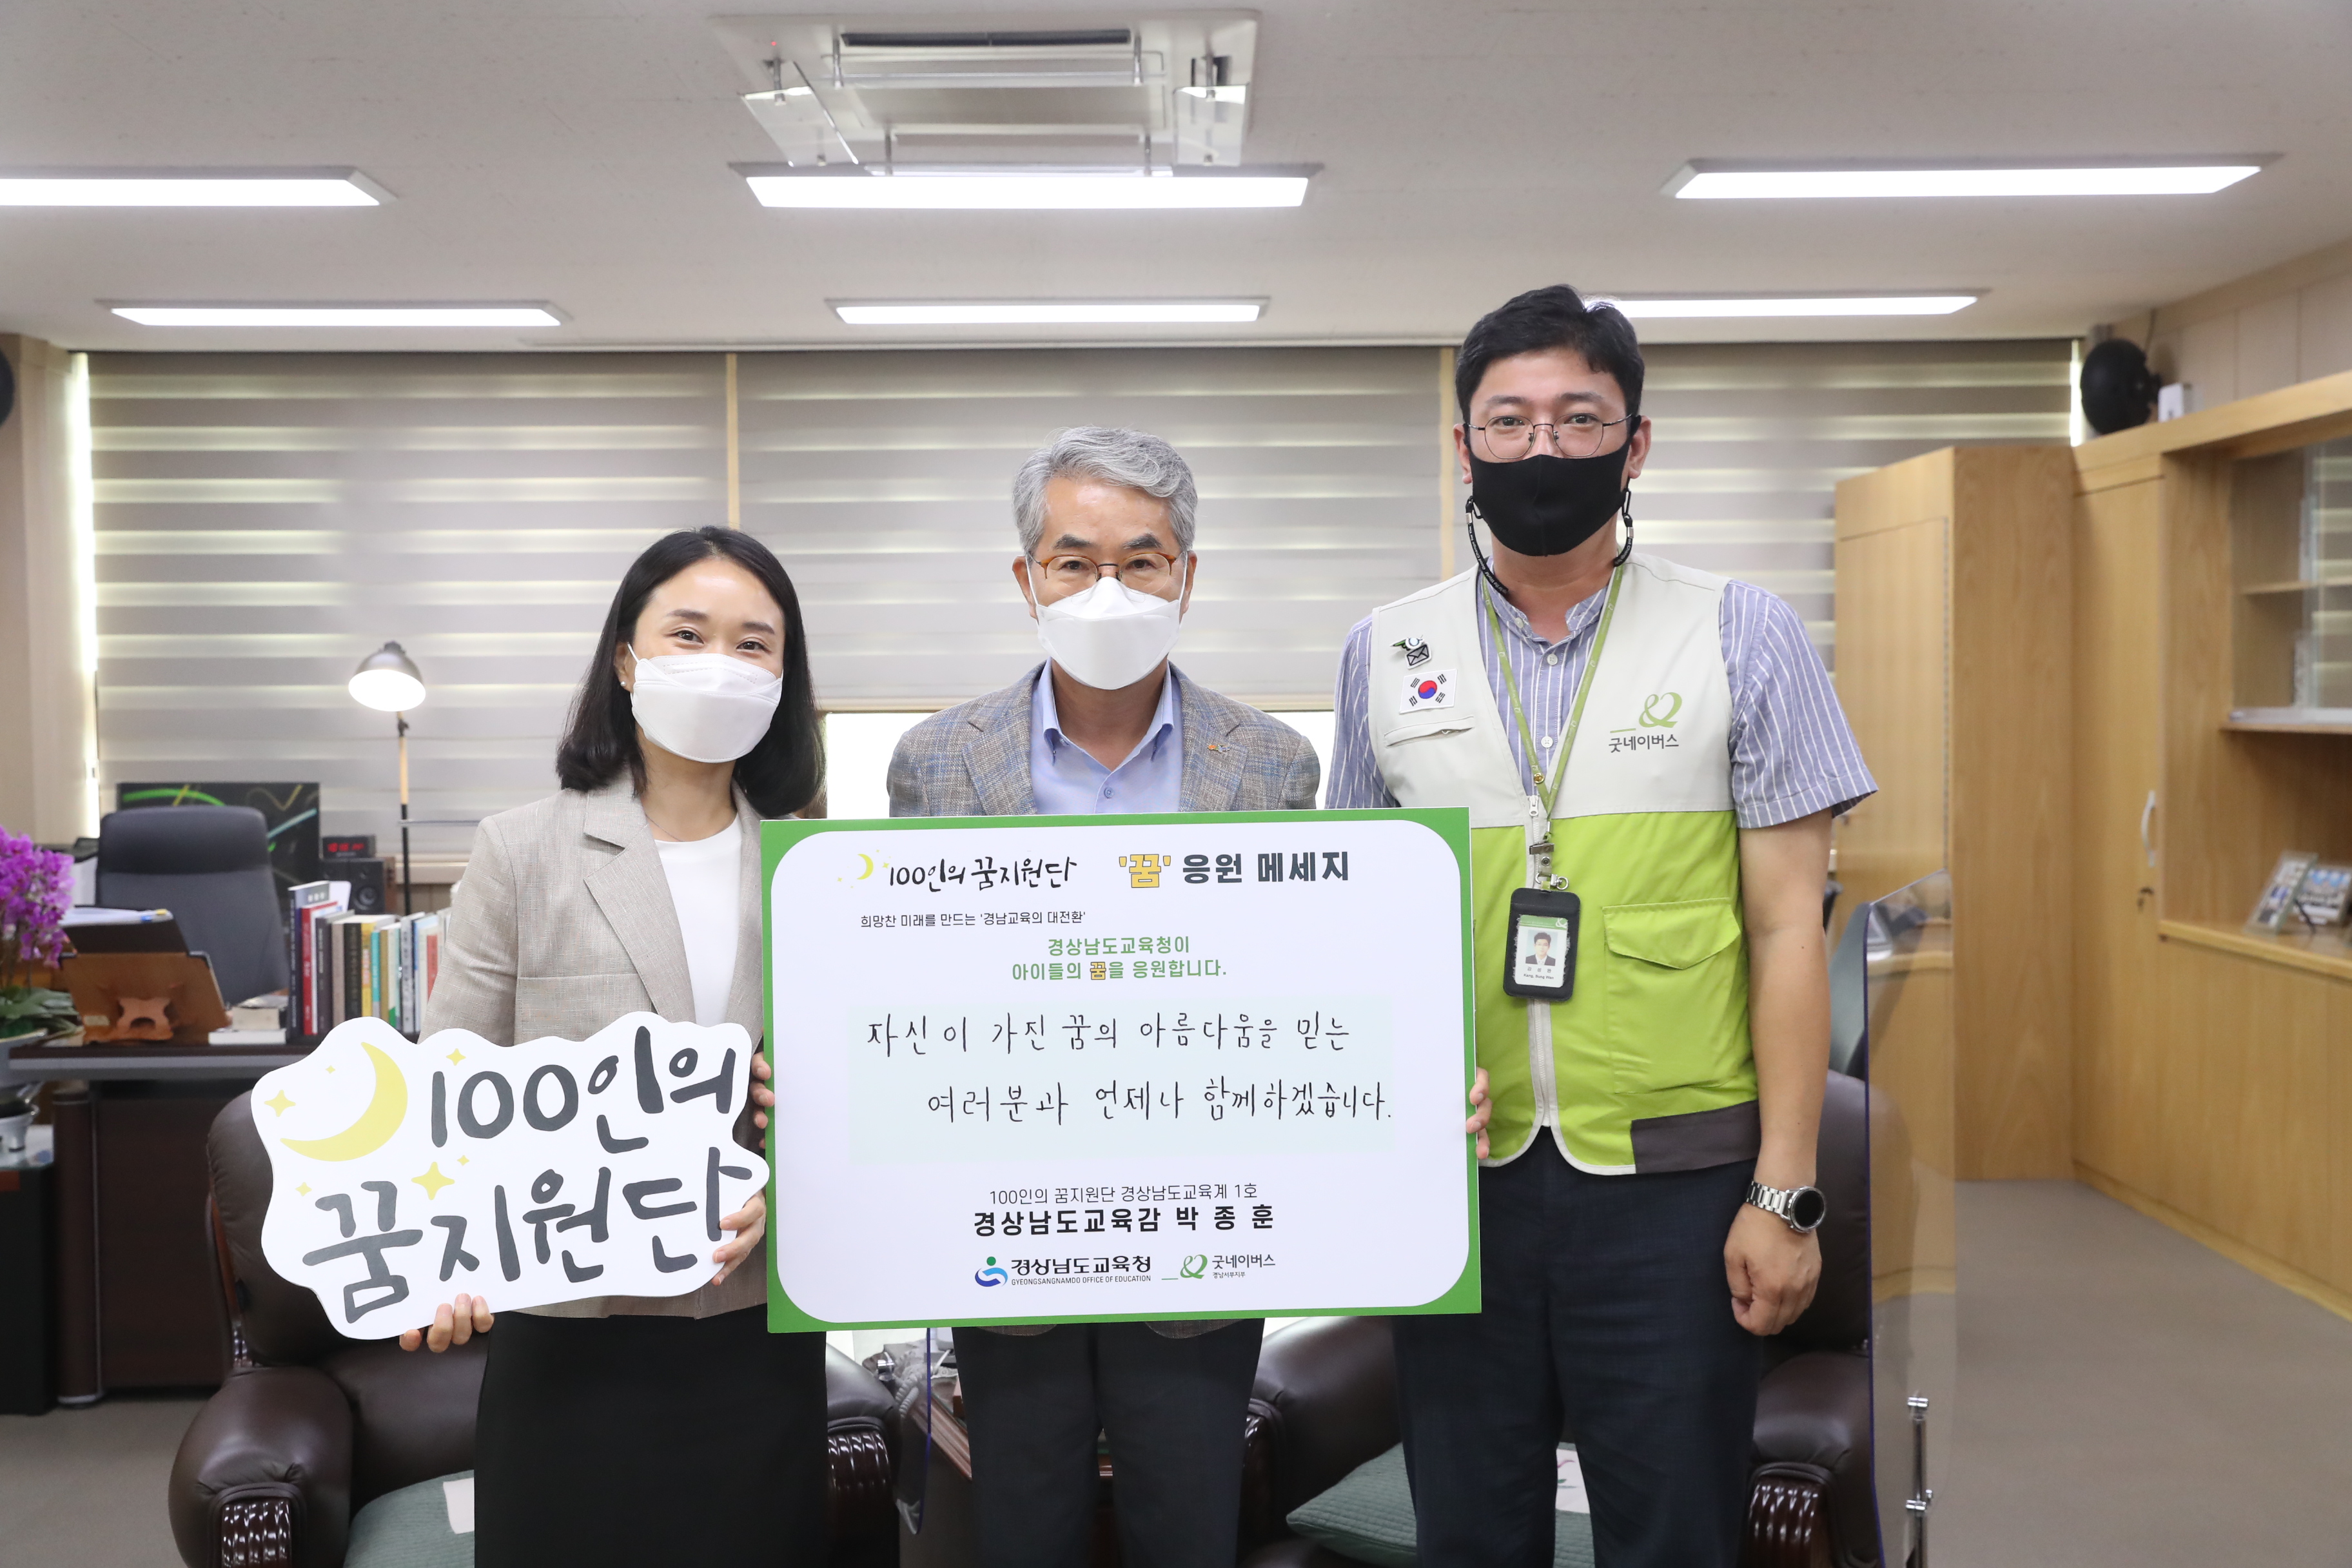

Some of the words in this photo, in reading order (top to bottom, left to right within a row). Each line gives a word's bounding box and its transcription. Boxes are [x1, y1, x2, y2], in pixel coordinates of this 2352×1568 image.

[1609, 734, 1679, 752] 굿네이버스
[1183, 854, 1242, 883] 응원
[1258, 852, 1348, 882] 메세지
[861, 916, 896, 927] 희망찬
[901, 915, 936, 926] 미래를
[941, 914, 975, 926] 만드는
[981, 912, 1042, 925] '경남교육의
[1048, 911, 1085, 923] 대전환'
[1048, 936, 1188, 956] 경상남도교육청이
[1013, 963, 1081, 980] 아이들의
[1090, 961, 1124, 980] 꿈을
[1133, 959, 1226, 978] 응원합니다.
[868, 1014, 966, 1057] 자신이
[992, 1013, 1044, 1054] 가진
[1062, 1015, 1115, 1050] 꿈의
[1141, 1013, 1277, 1050] 아름다움을
[1298, 1011, 1349, 1050] 믿는
[432, 1026, 736, 1153] 100인의
[928, 1083, 1068, 1125] 여러분과
[1096, 1080, 1184, 1120] 언제나
[1204, 1076, 1391, 1121] 함께하겠습니다.
[990, 1189, 1047, 1204] 100인의
[1055, 1187, 1115, 1203] 꿈지원단
[1122, 1184, 1226, 1202] 경상남도교육계
[1235, 1183, 1257, 1197] 1호
[975, 1208, 1161, 1237] 경상남도교육감
[302, 1146, 753, 1324] 꿈지원단
[1012, 1256, 1151, 1276] 경상남도교육청
[1212, 1255, 1275, 1269] 굿네이버스
